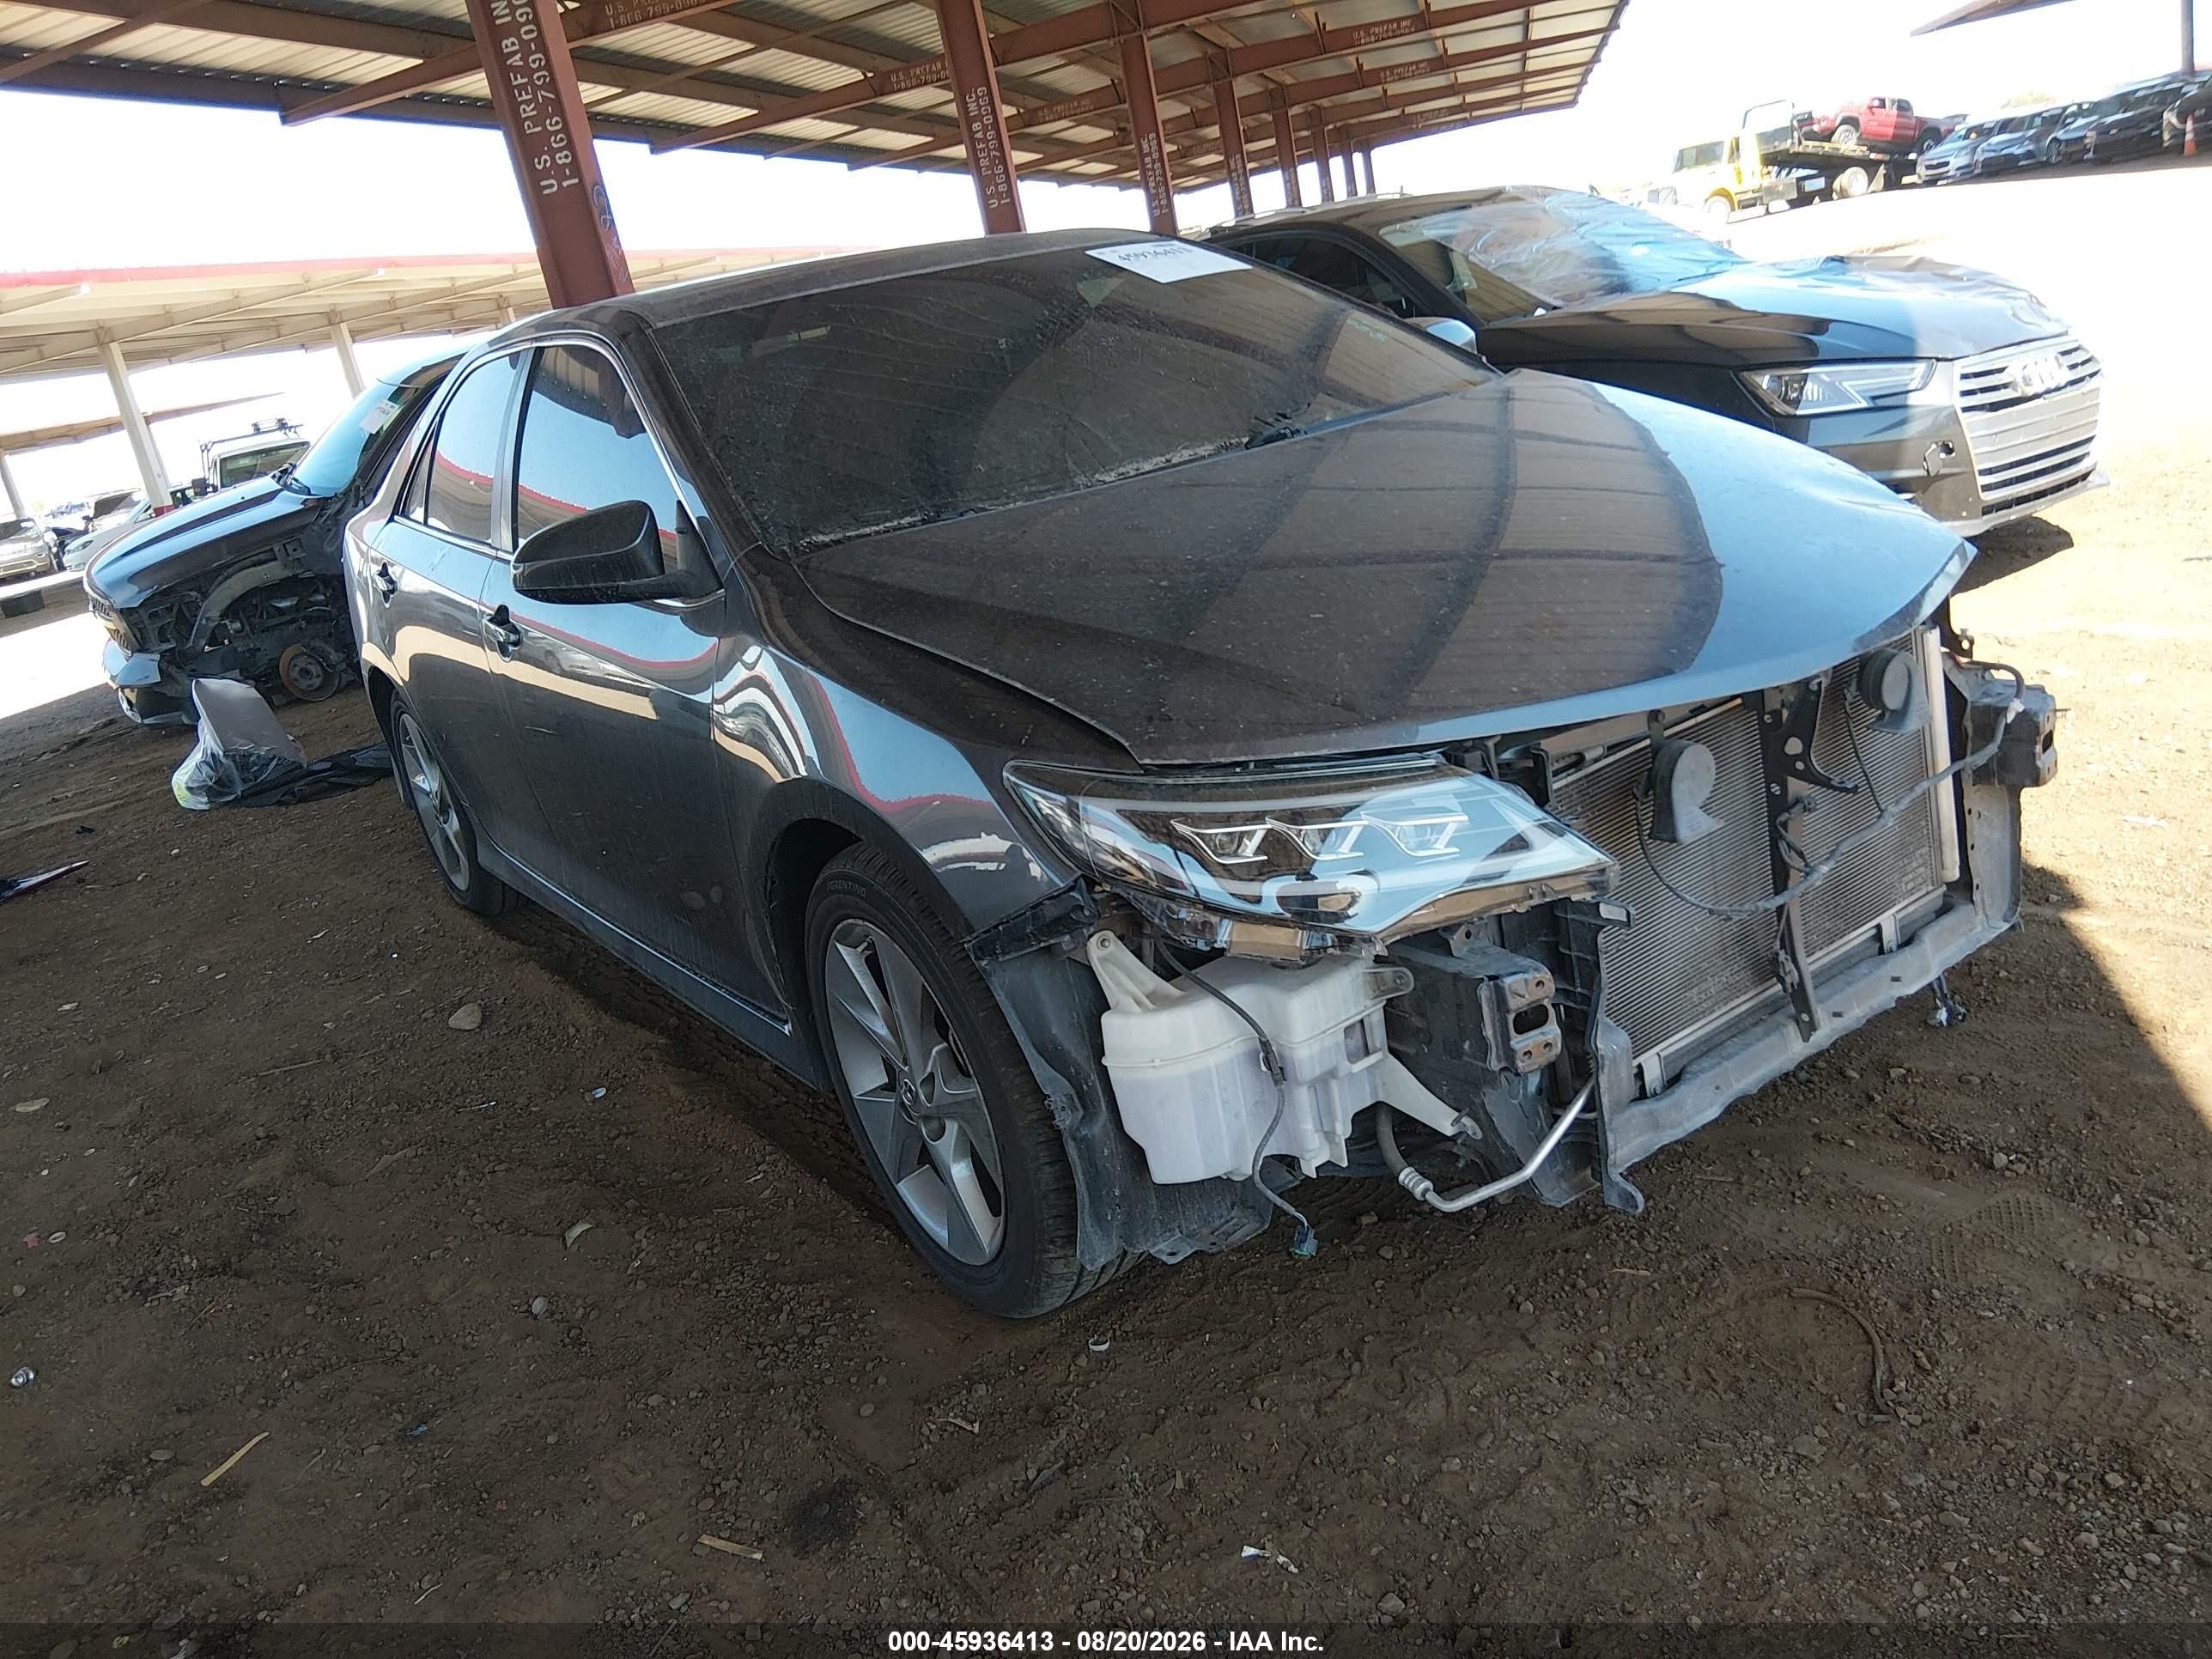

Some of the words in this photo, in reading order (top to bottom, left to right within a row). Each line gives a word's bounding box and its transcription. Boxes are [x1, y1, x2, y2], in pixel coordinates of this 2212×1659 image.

[501, 36, 543, 135] PREFAB
[534, 146, 559, 195] U.S.
[972, 121, 992, 176] PREFAB
[977, 86, 1011, 205] 1-866-799-0969
[986, 180, 998, 209] U.S.
